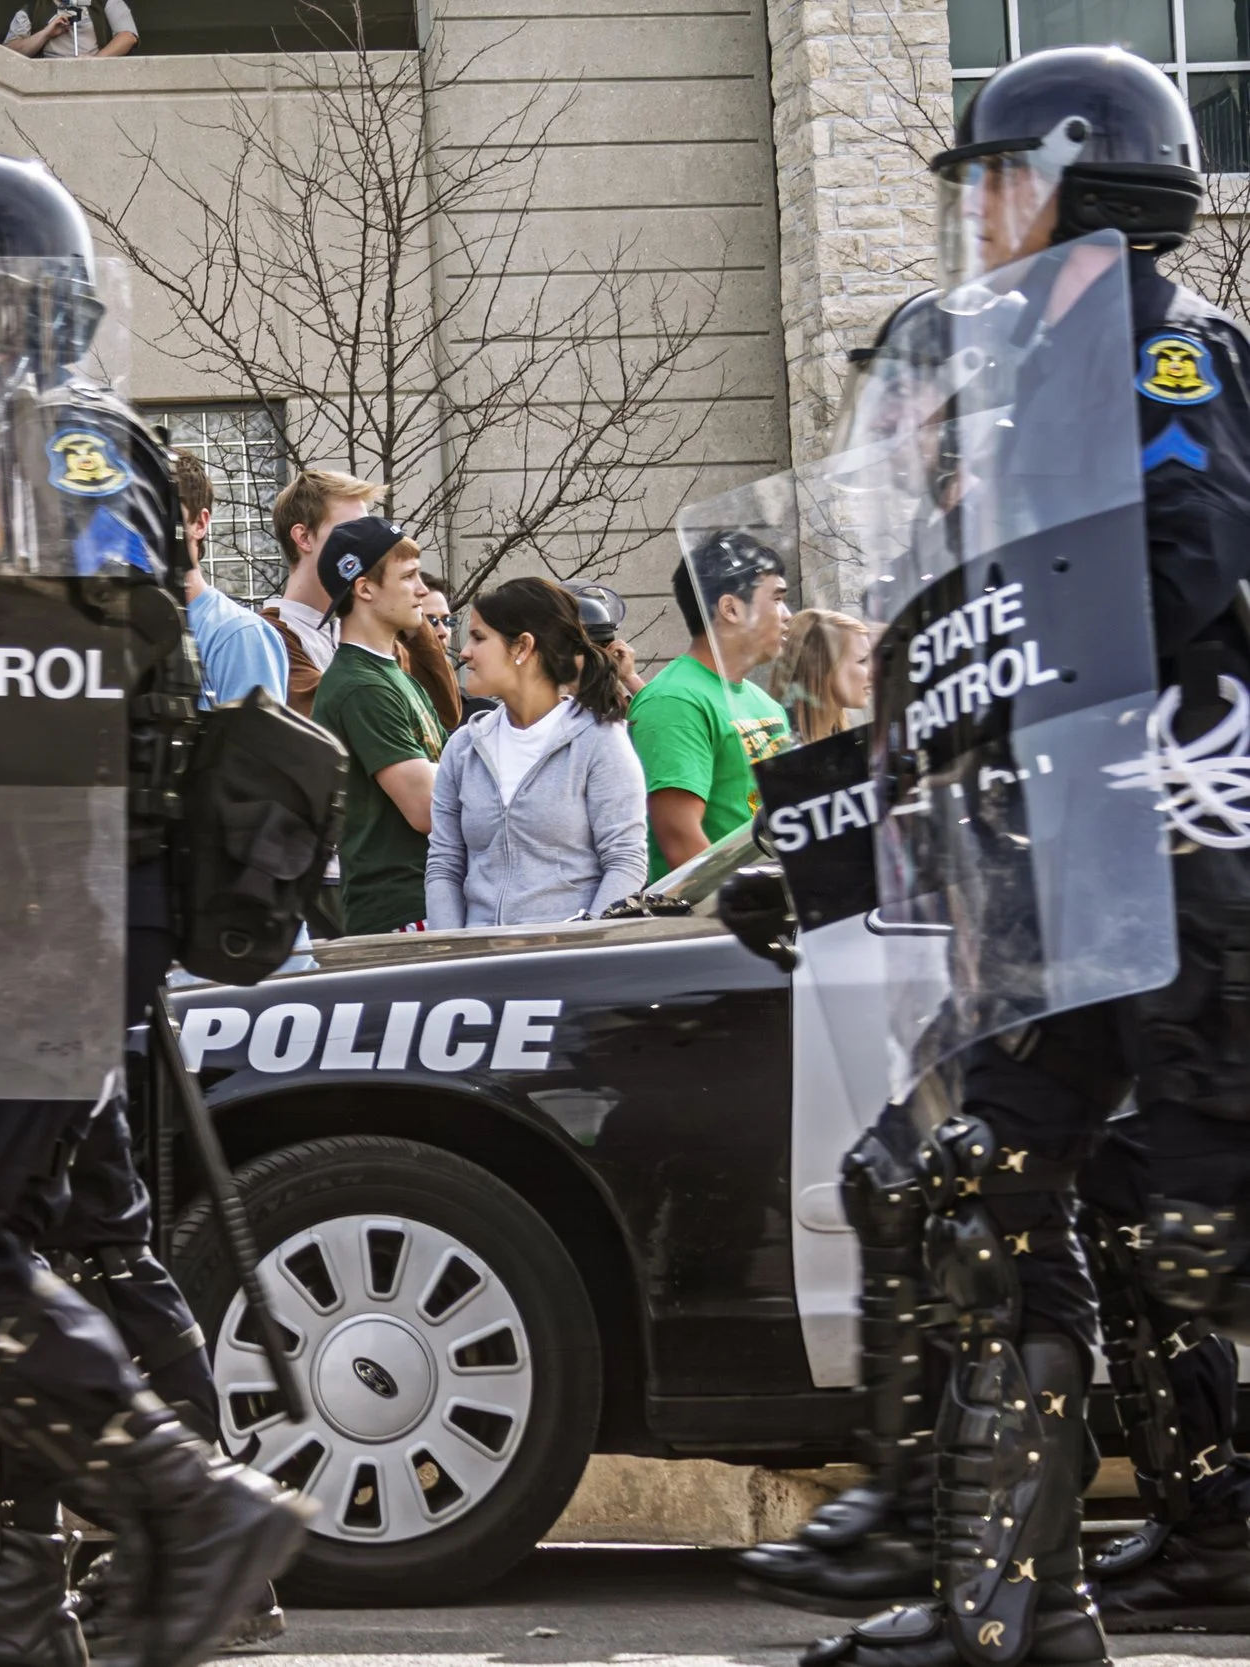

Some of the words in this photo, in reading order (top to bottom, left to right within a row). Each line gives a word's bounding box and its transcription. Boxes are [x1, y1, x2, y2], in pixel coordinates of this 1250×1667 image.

[907, 582, 1026, 684] STATE
[904, 640, 1060, 750] PATROL
[178, 998, 562, 1073] POLICE
